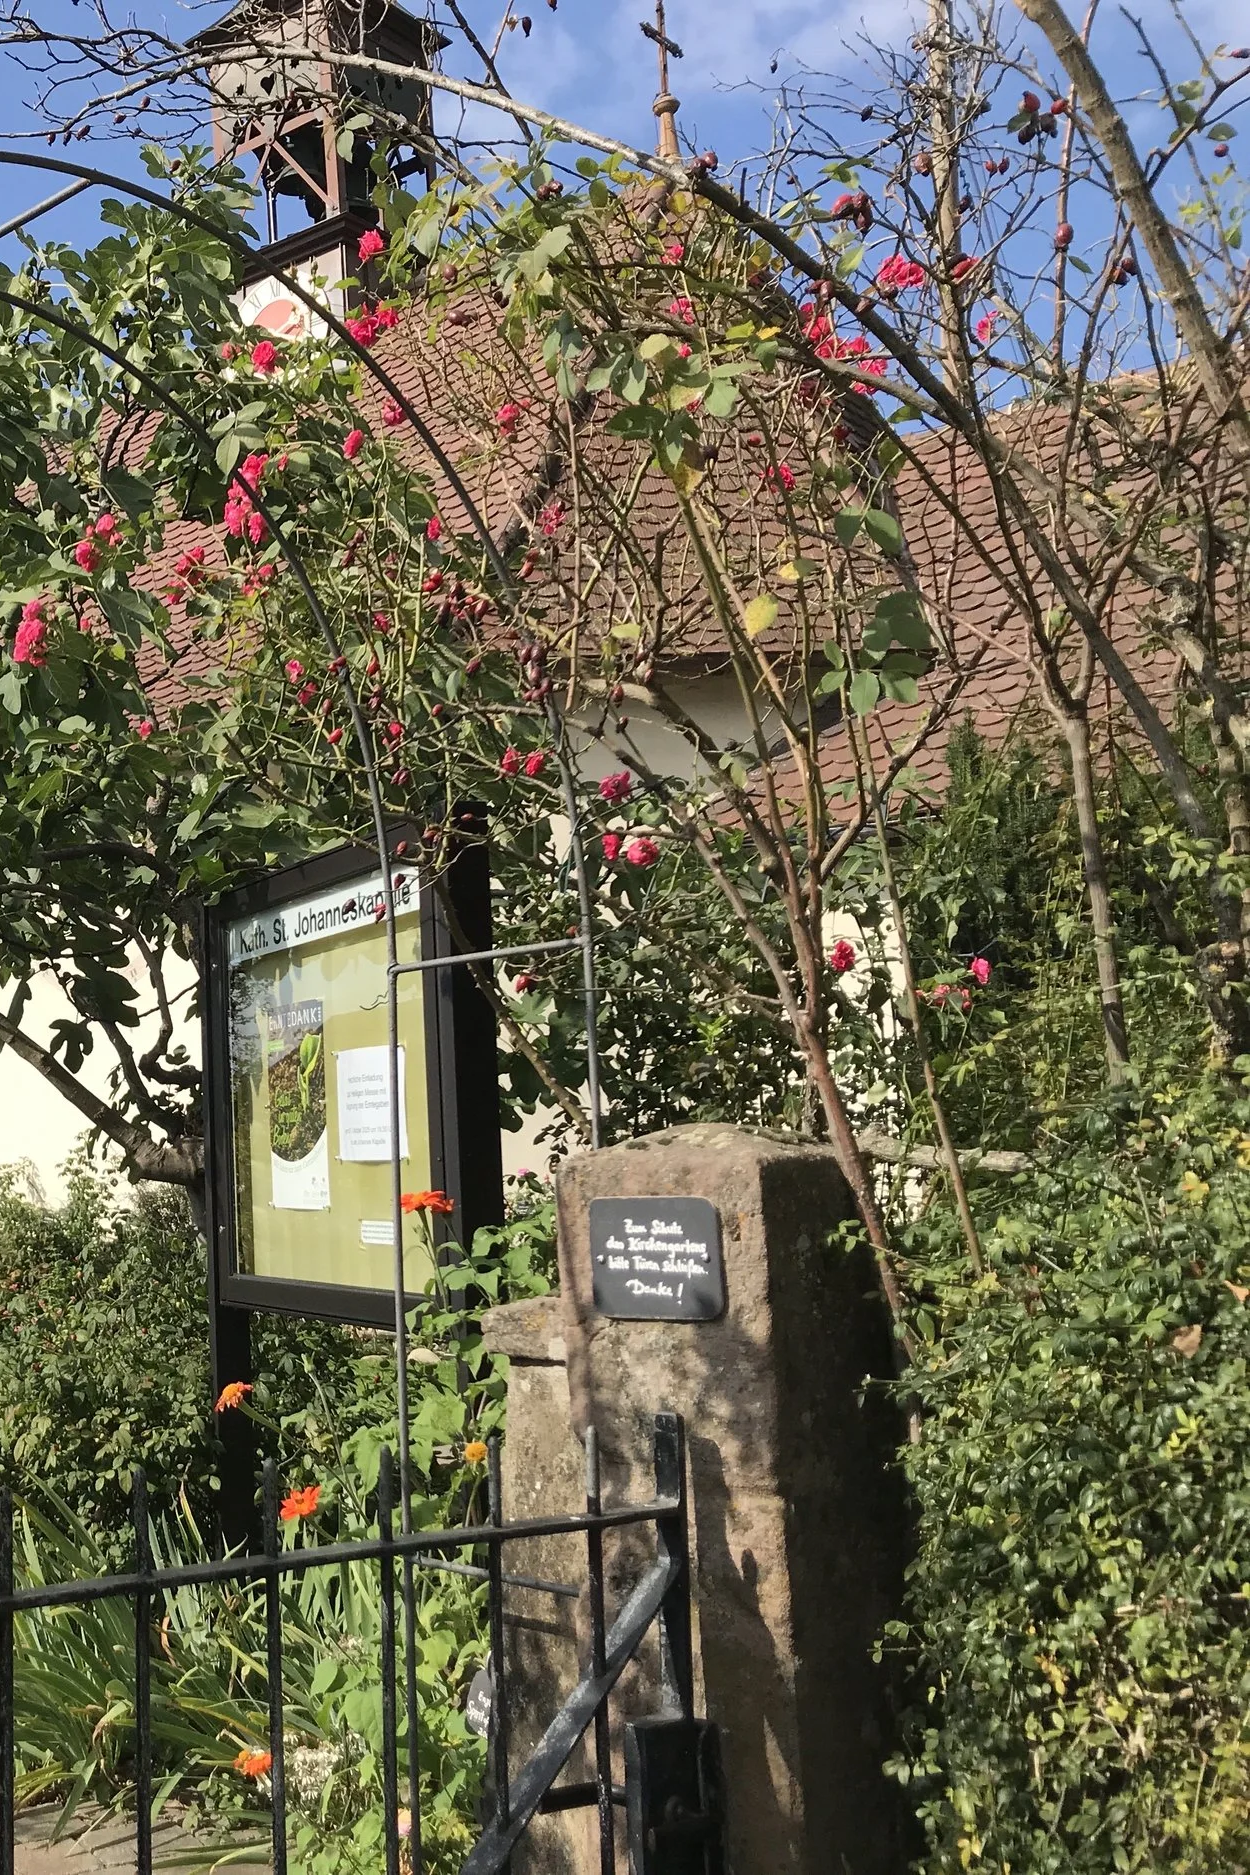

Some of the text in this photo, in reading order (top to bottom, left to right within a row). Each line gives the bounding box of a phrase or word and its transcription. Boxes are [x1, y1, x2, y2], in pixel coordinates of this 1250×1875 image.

[273, 918, 289, 944] St.
[294, 883, 411, 938] Johanneskaplle
[623, 1218, 684, 1235] Zum Schutz
[627, 1236, 707, 1259] Kirchengartens
[608, 1254, 630, 1269] bitte
